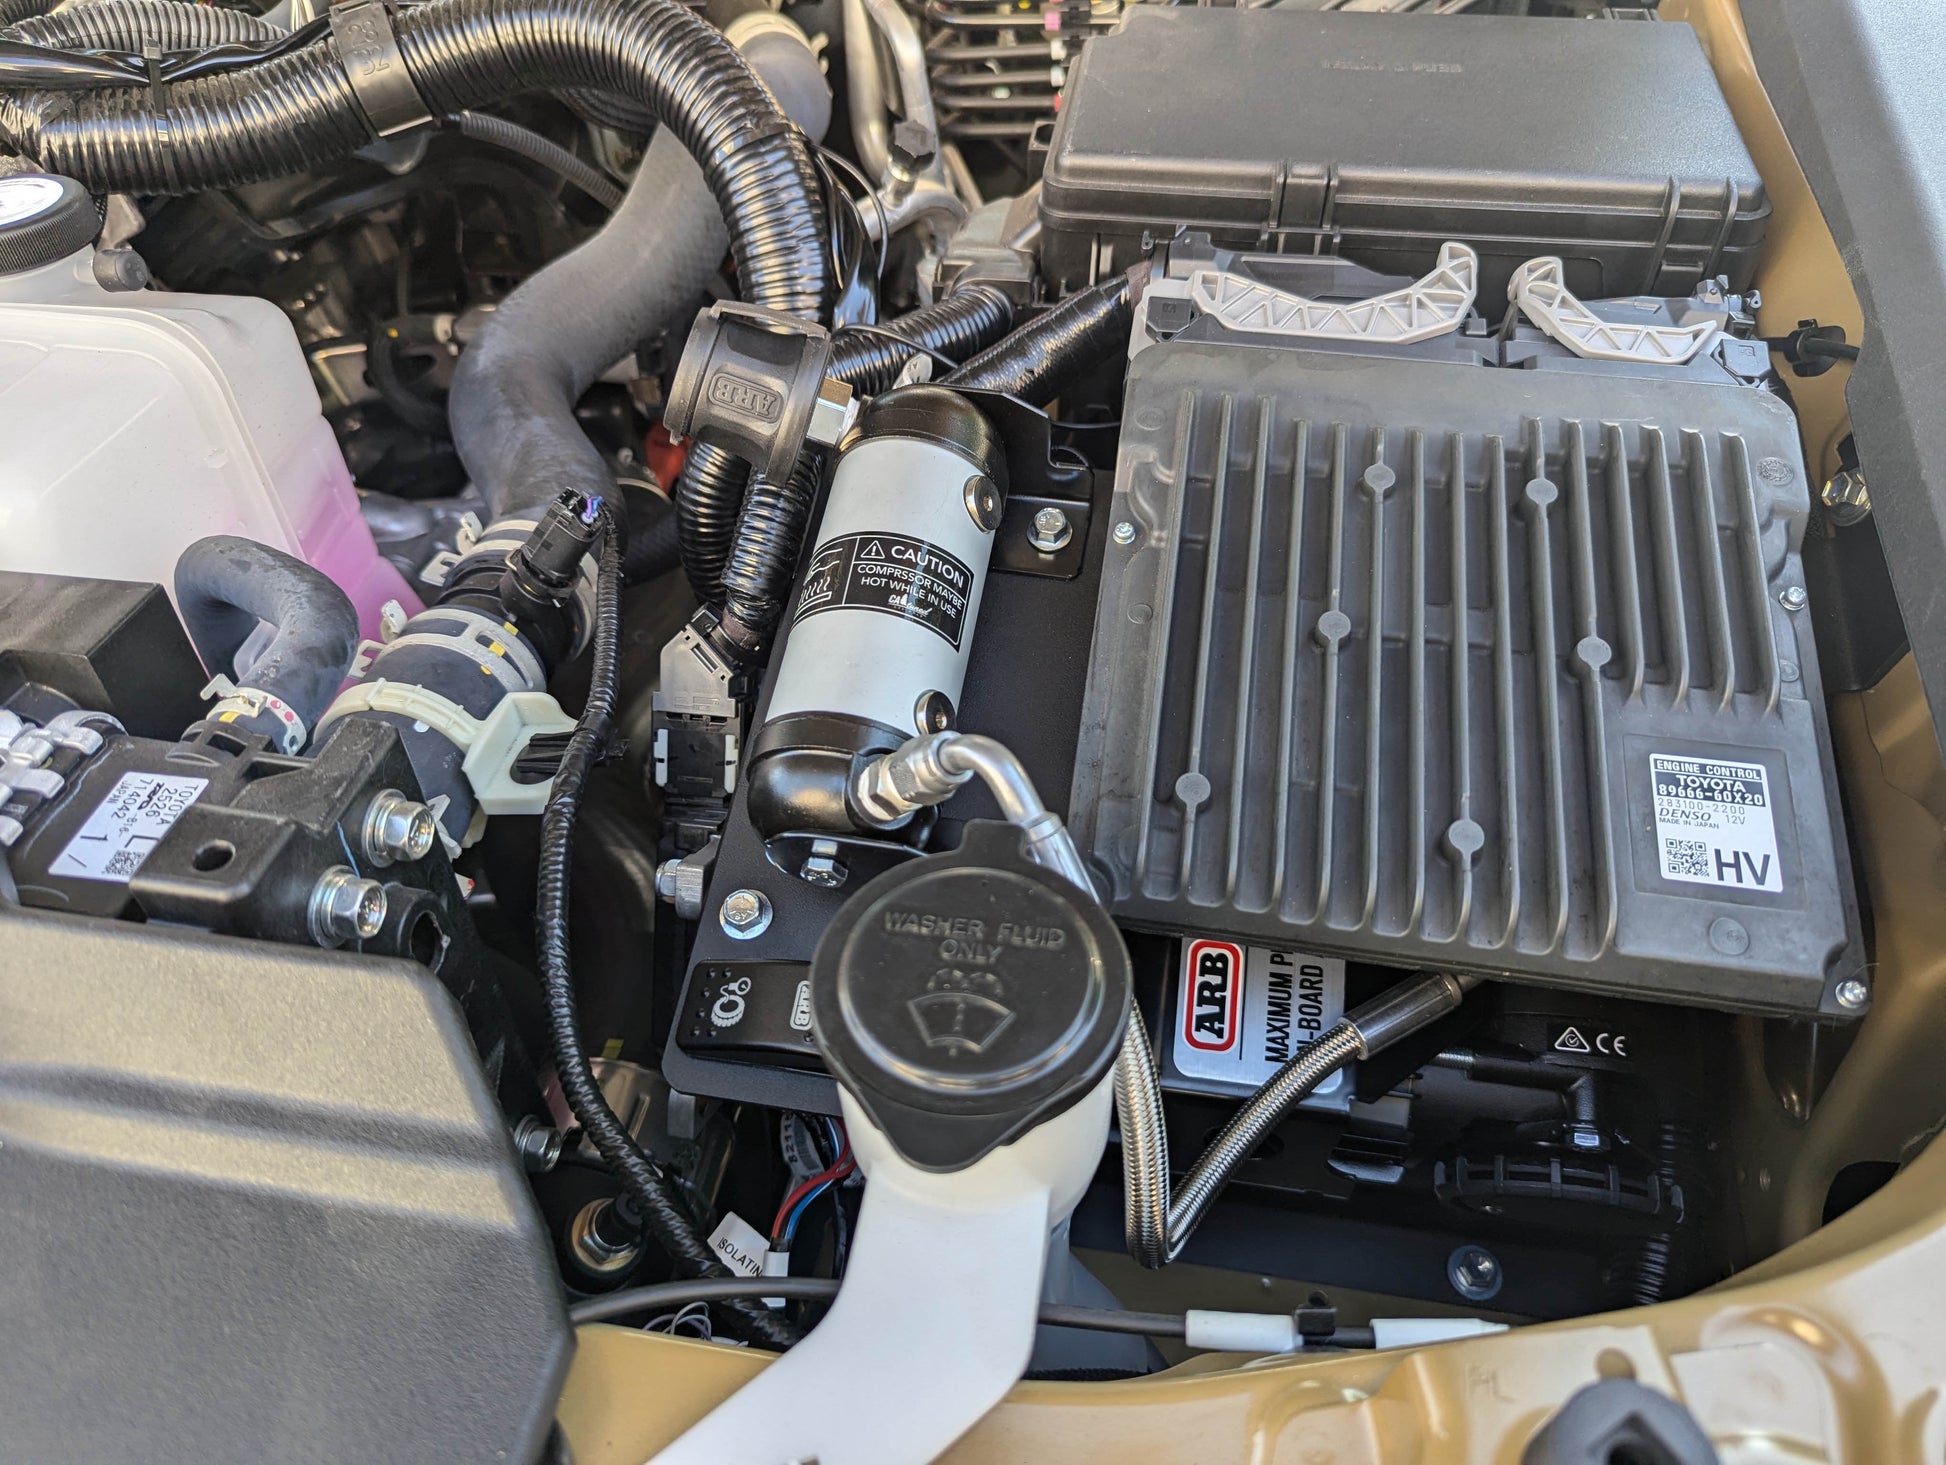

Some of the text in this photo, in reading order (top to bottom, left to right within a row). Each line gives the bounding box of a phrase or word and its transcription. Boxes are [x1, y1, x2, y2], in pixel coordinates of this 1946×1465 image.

[348, 20, 379, 48] 28
[716, 380, 777, 416] ARB
[891, 546, 964, 588] CAUTION
[857, 565, 963, 611] COMPRSSOR MAYBE
[860, 576, 889, 587] HOT
[889, 580, 926, 600] WHILE
[927, 592, 941, 606] IN
[940, 601, 957, 619] USE
[1656, 760, 1761, 780] ENGINE CONTROL
[1675, 774, 1747, 793] TOYOTA
[107, 780, 133, 804] JAPAN
[145, 787, 174, 817] 2526
[156, 784, 200, 826] TOYOTA
[1658, 783, 1764, 806] 89666-60X20
[1658, 798, 1745, 815] 283100-2200
[1659, 807, 1746, 826] DENSO 12V
[1659, 817, 1720, 830] MADE IN JAPAN
[1713, 848, 1771, 886] HV
[884, 910, 1067, 951] WASHER FLUID
[938, 938, 1003, 965] ONLY
[1194, 952, 1230, 1040] ARB
[1264, 971, 1294, 1064] MAXIMUM
[1595, 1032, 1627, 1057] CE
